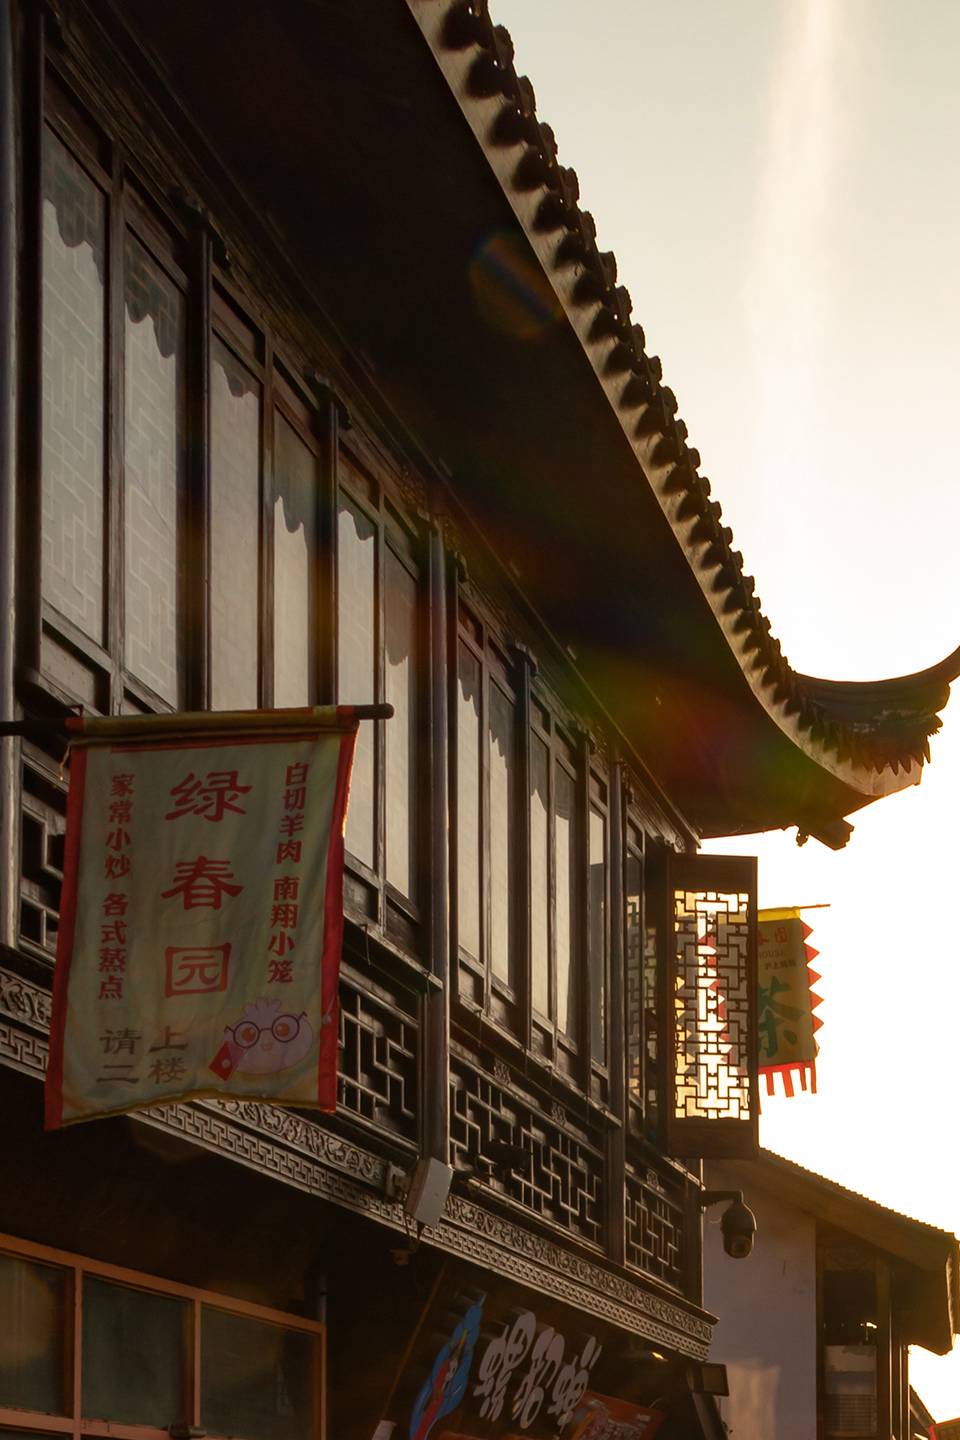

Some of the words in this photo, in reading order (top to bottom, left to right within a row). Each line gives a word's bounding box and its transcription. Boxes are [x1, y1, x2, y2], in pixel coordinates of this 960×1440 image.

[104, 773, 136, 880] 家常小炒
[275, 762, 309, 865] 白切羊肉
[161, 769, 252, 999] 绿春园
[267, 876, 300, 985] 南翔小笼
[97, 893, 129, 1001] 各式蒸点
